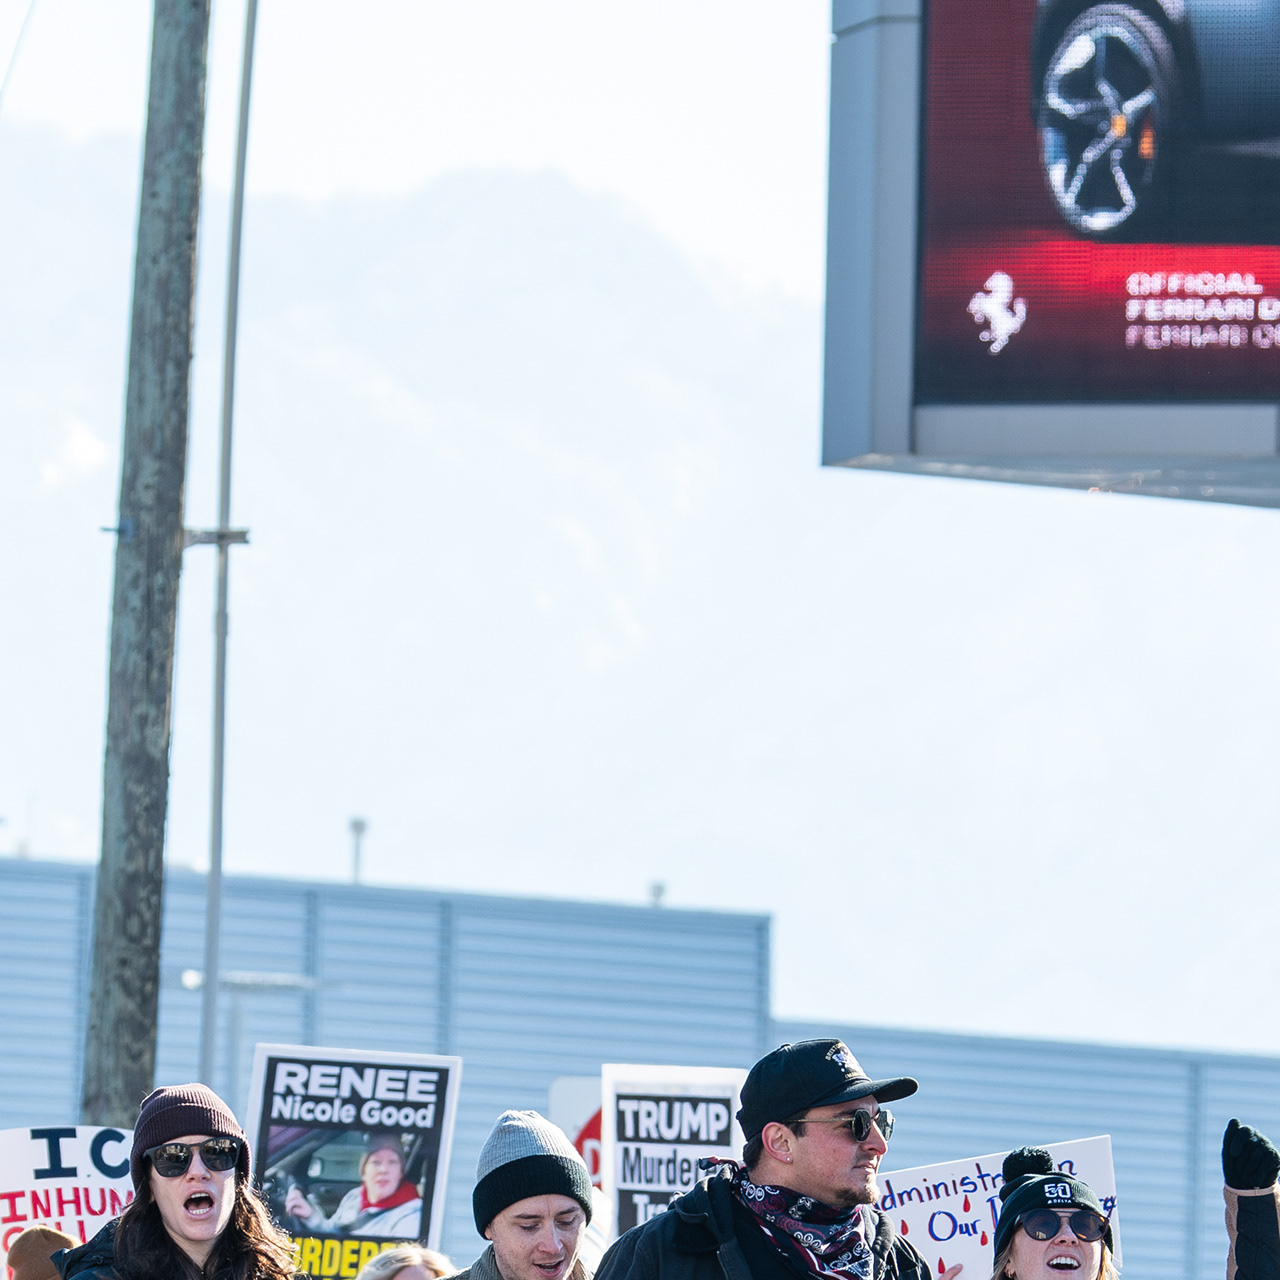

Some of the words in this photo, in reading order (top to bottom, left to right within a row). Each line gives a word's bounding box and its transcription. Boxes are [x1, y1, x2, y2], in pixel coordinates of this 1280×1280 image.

[1126, 272, 1264, 295] OFFICIAL
[1126, 297, 1254, 321] FERRARI
[273, 1061, 439, 1103] RENEE
[271, 1094, 357, 1124] Nicole
[360, 1099, 436, 1129] Good
[618, 1098, 730, 1142] TRUMP
[30, 1127, 131, 1180] IC
[1044, 1182, 1071, 1198] 50
[928, 1210, 981, 1242] Our
